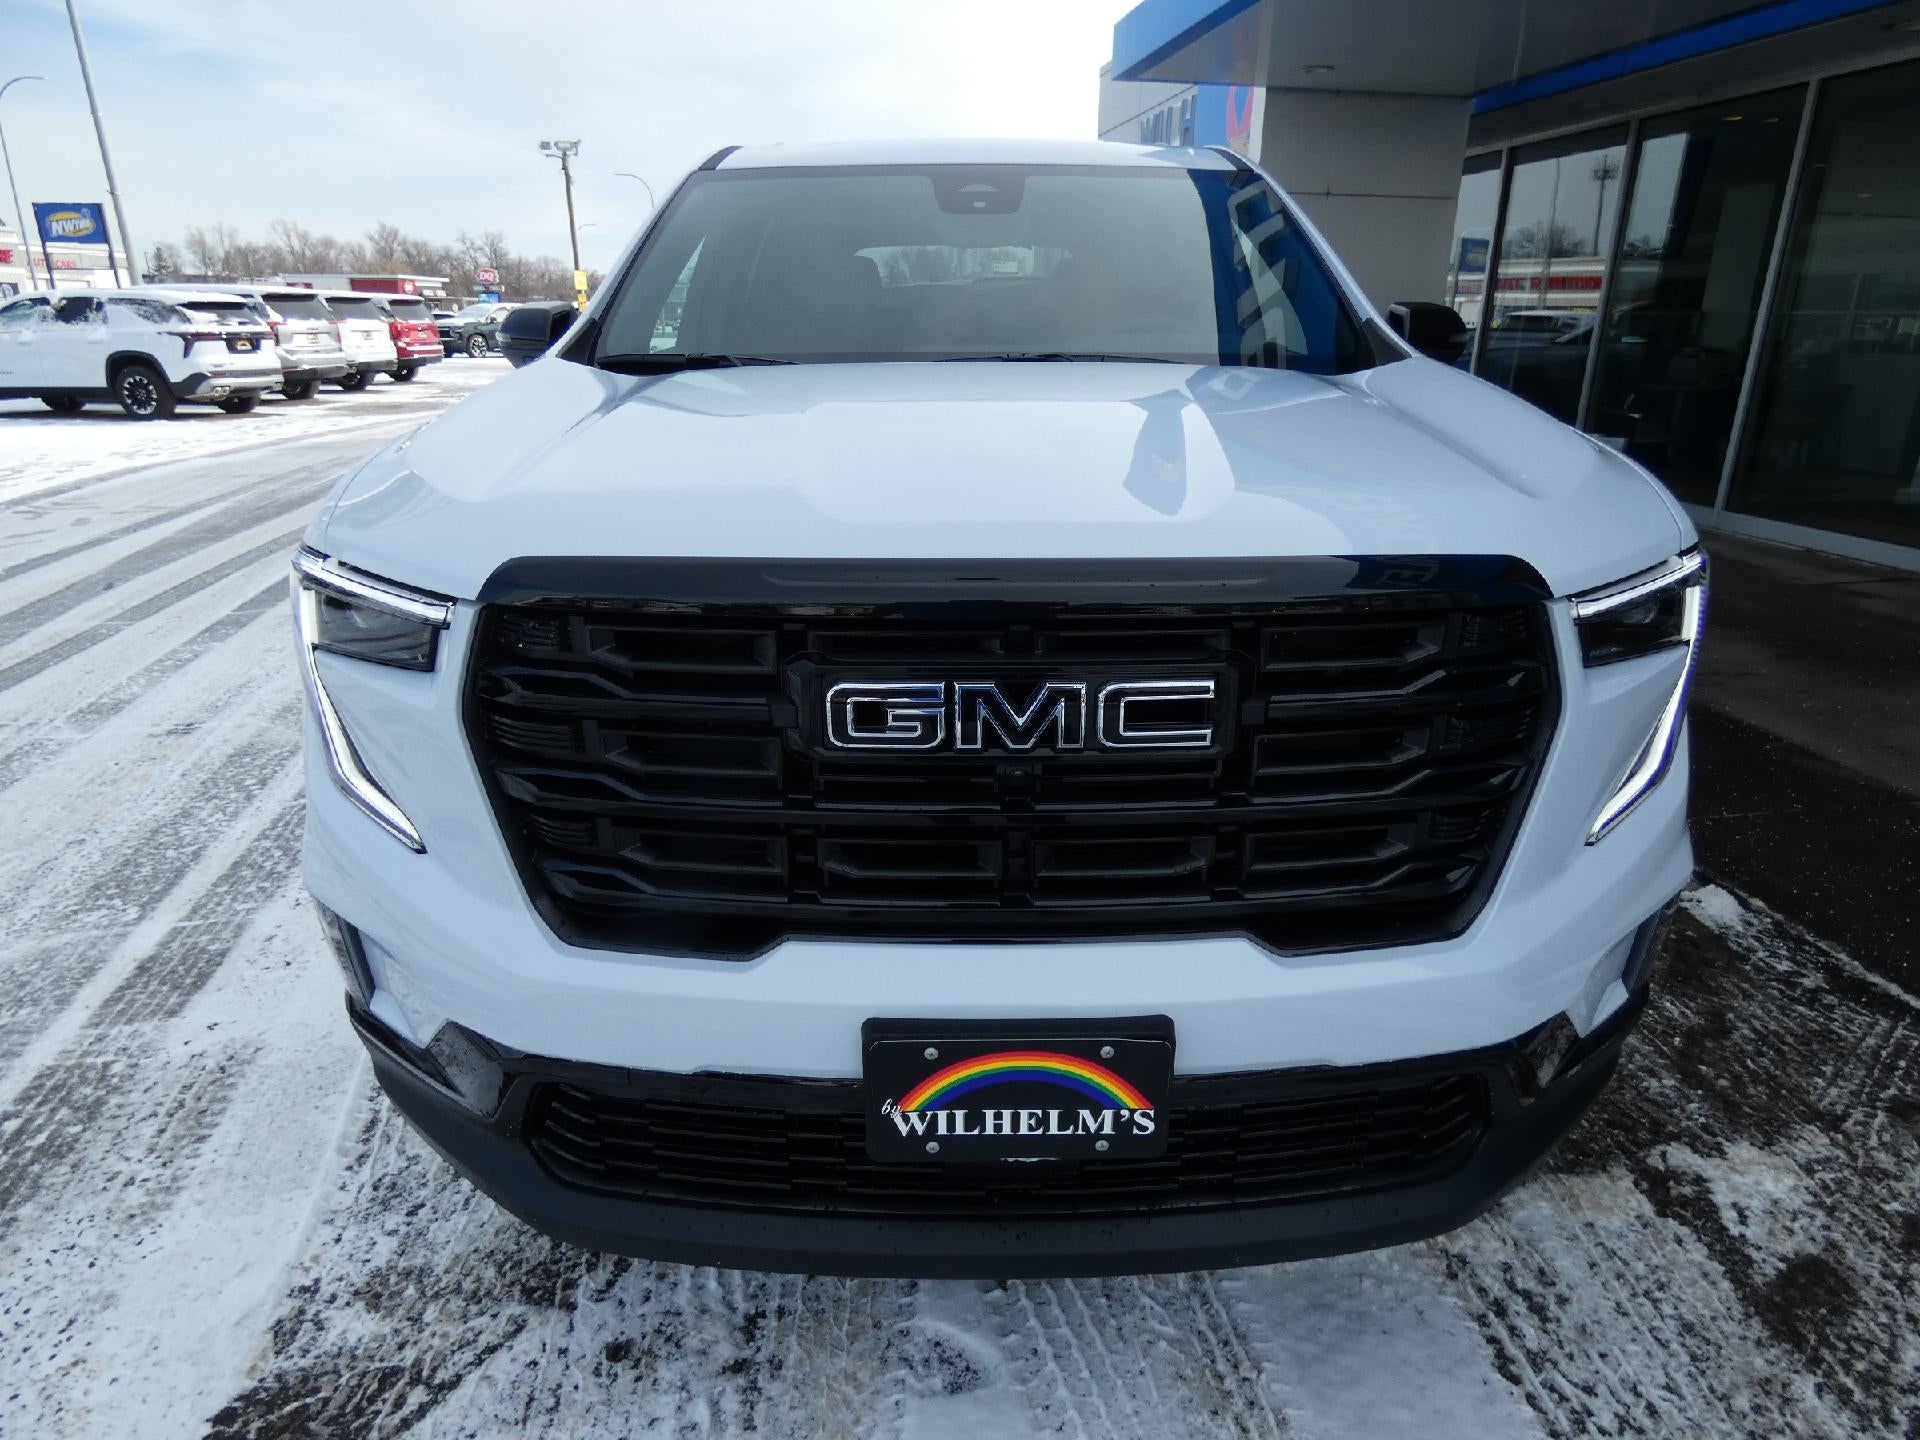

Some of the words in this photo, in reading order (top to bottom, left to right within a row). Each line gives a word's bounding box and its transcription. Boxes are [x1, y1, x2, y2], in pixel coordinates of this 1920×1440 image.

[826, 681, 1215, 749] GMC
[881, 1099, 903, 1118] by
[893, 1109, 1156, 1137] WILHELM'S
